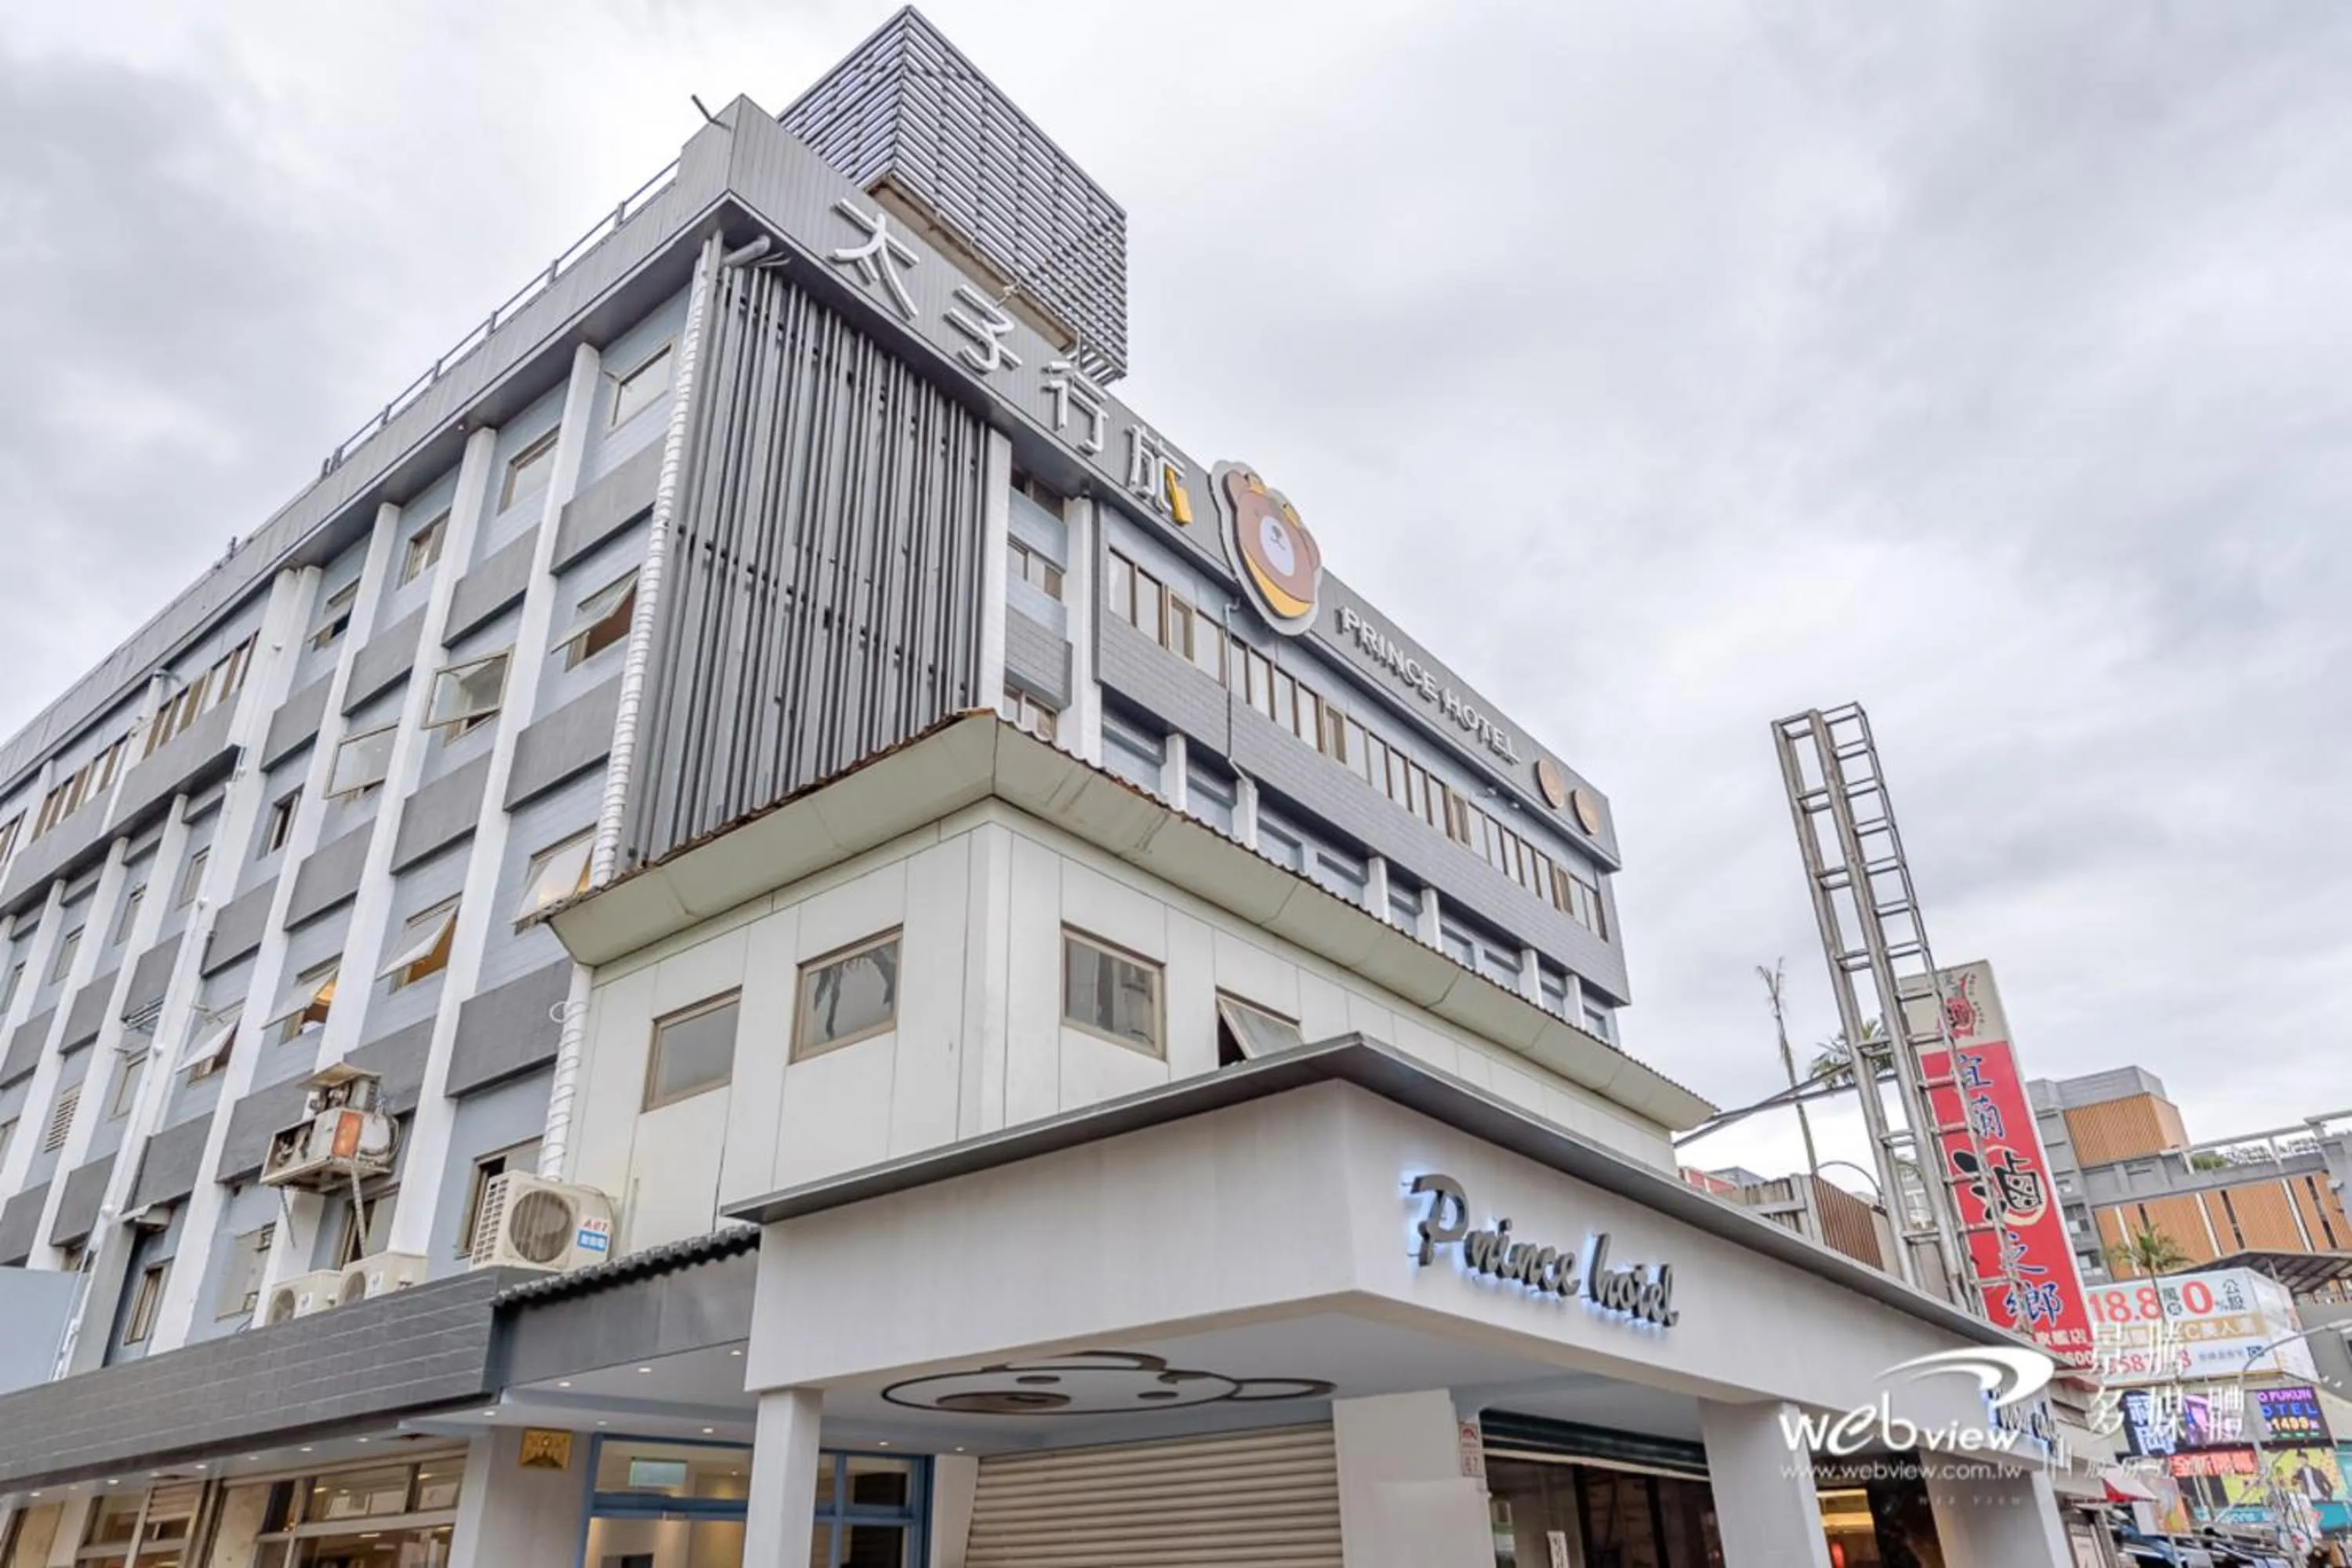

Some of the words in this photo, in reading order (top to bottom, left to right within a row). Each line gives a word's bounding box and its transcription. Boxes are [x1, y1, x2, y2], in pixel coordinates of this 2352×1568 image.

[1335, 606, 1439, 702] PRINCE
[1439, 687, 1521, 766] HOTEL
[1411, 1174, 1581, 1297] Prince
[1589, 1232, 1679, 1327] hotel
